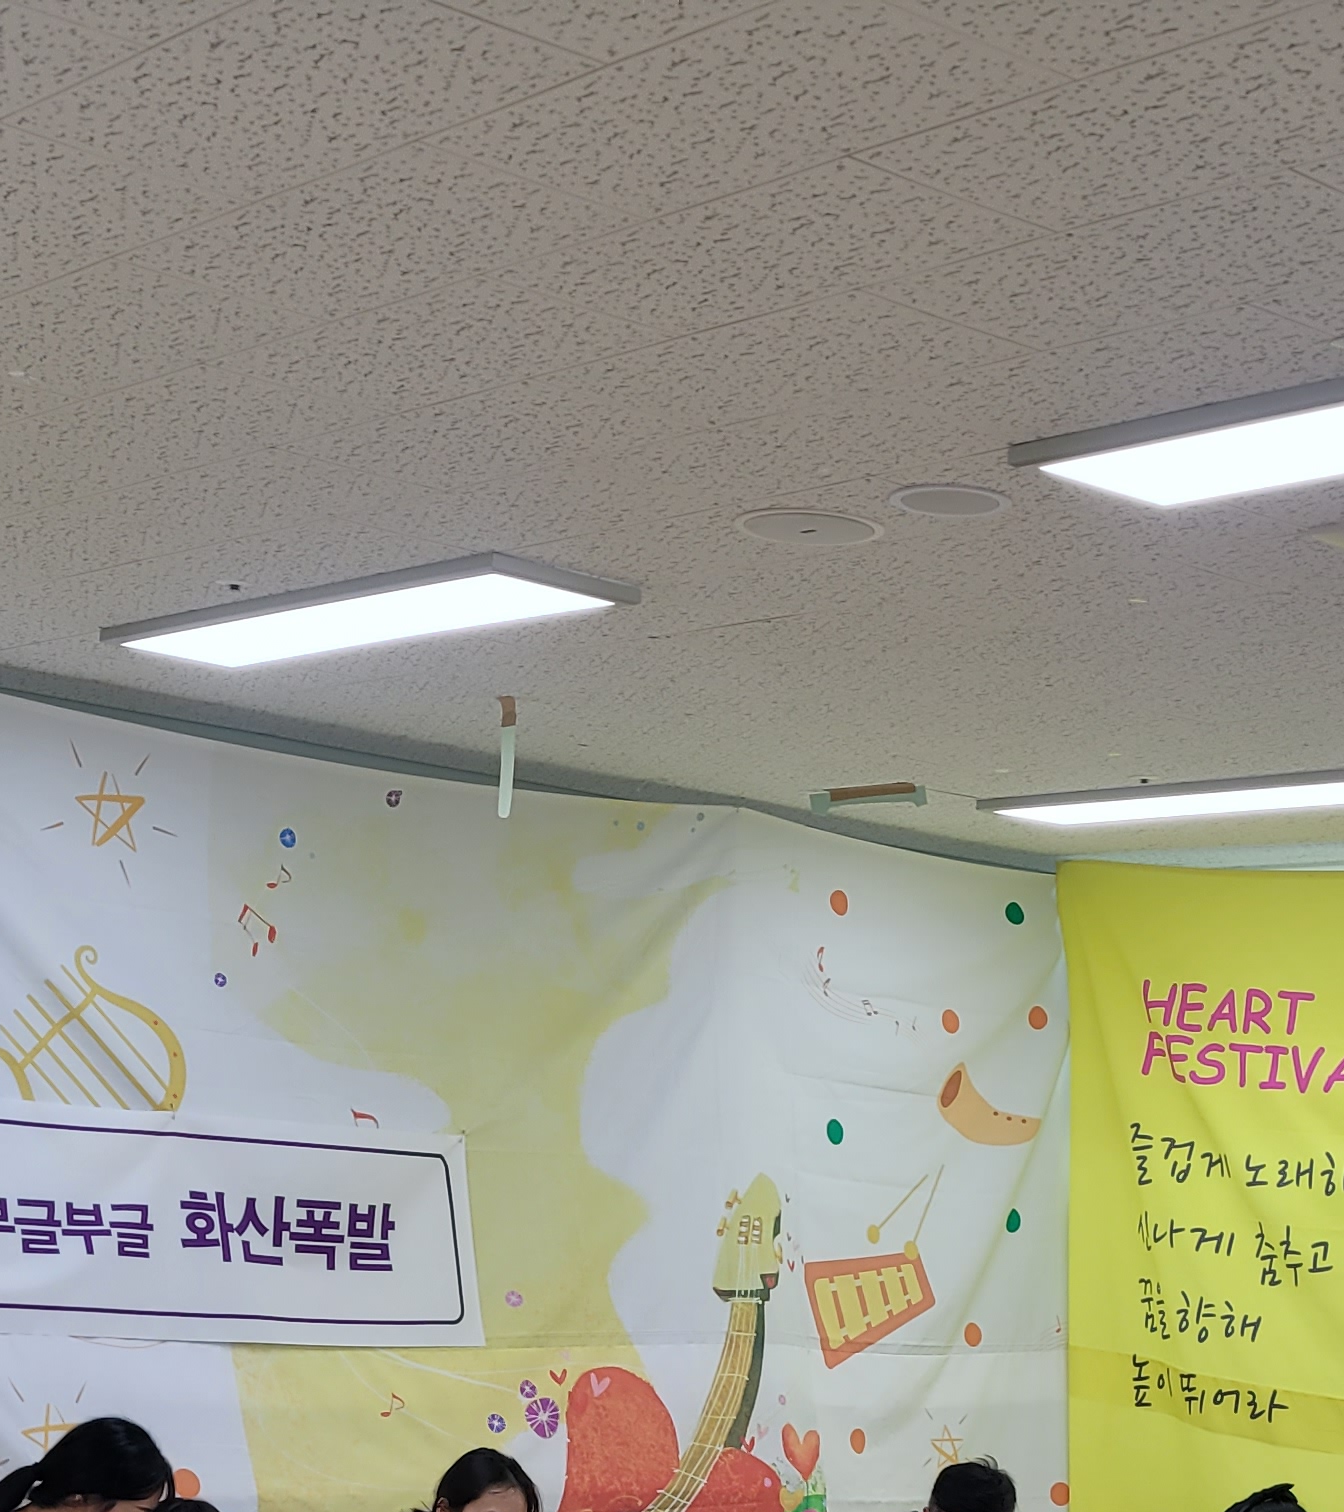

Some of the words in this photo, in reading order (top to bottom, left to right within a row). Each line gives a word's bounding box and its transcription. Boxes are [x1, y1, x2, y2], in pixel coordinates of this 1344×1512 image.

[1142, 978, 1316, 1036] HEART
[1129, 1121, 1233, 1188] 즐겁게
[179, 1188, 398, 1273] 화산폭발
[1137, 1210, 1236, 1257] 신나게
[1254, 1220, 1335, 1288] 춤추고
[1137, 1277, 1171, 1341] 꿈을
[1174, 1289, 1263, 1344] 향해
[1131, 1353, 1174, 1409] 높이
[1178, 1372, 1290, 1424] 뛰어라
